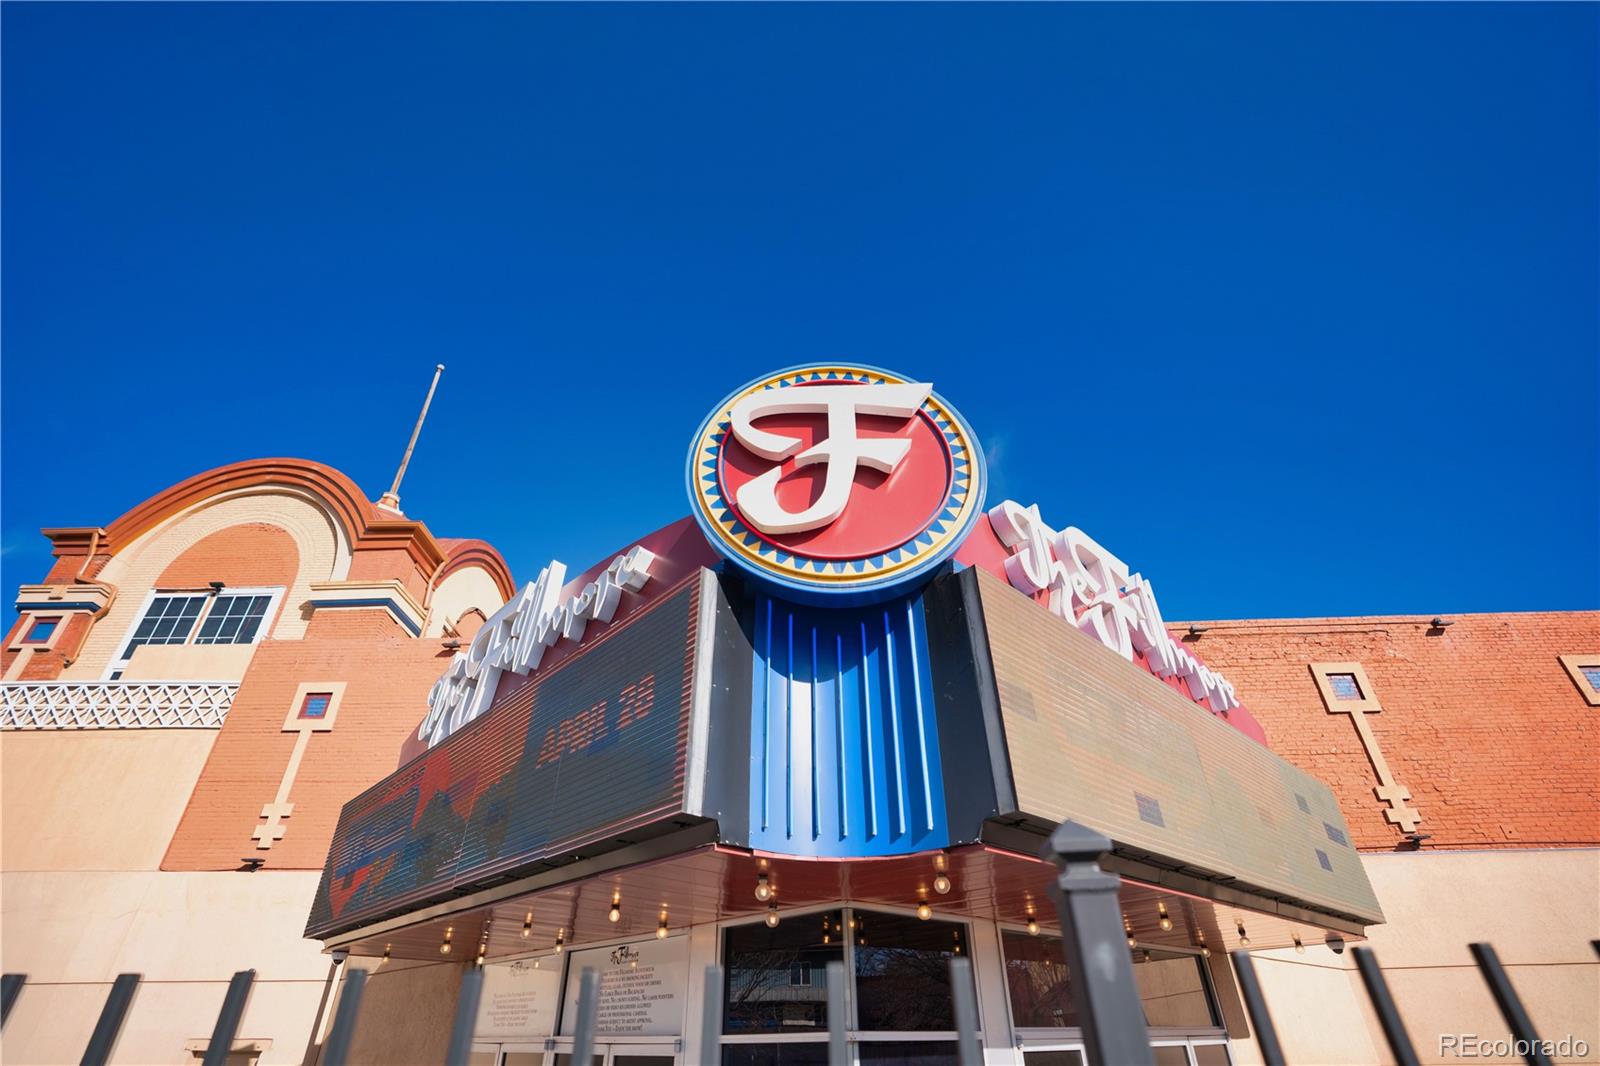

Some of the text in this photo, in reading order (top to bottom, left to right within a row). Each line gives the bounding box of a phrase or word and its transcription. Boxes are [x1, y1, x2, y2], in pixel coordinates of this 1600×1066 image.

[730, 383, 933, 534] F
[450, 545, 655, 735] Fillmore
[988, 499, 1240, 713] The Fillmore
[536, 699, 609, 769] APRIL
